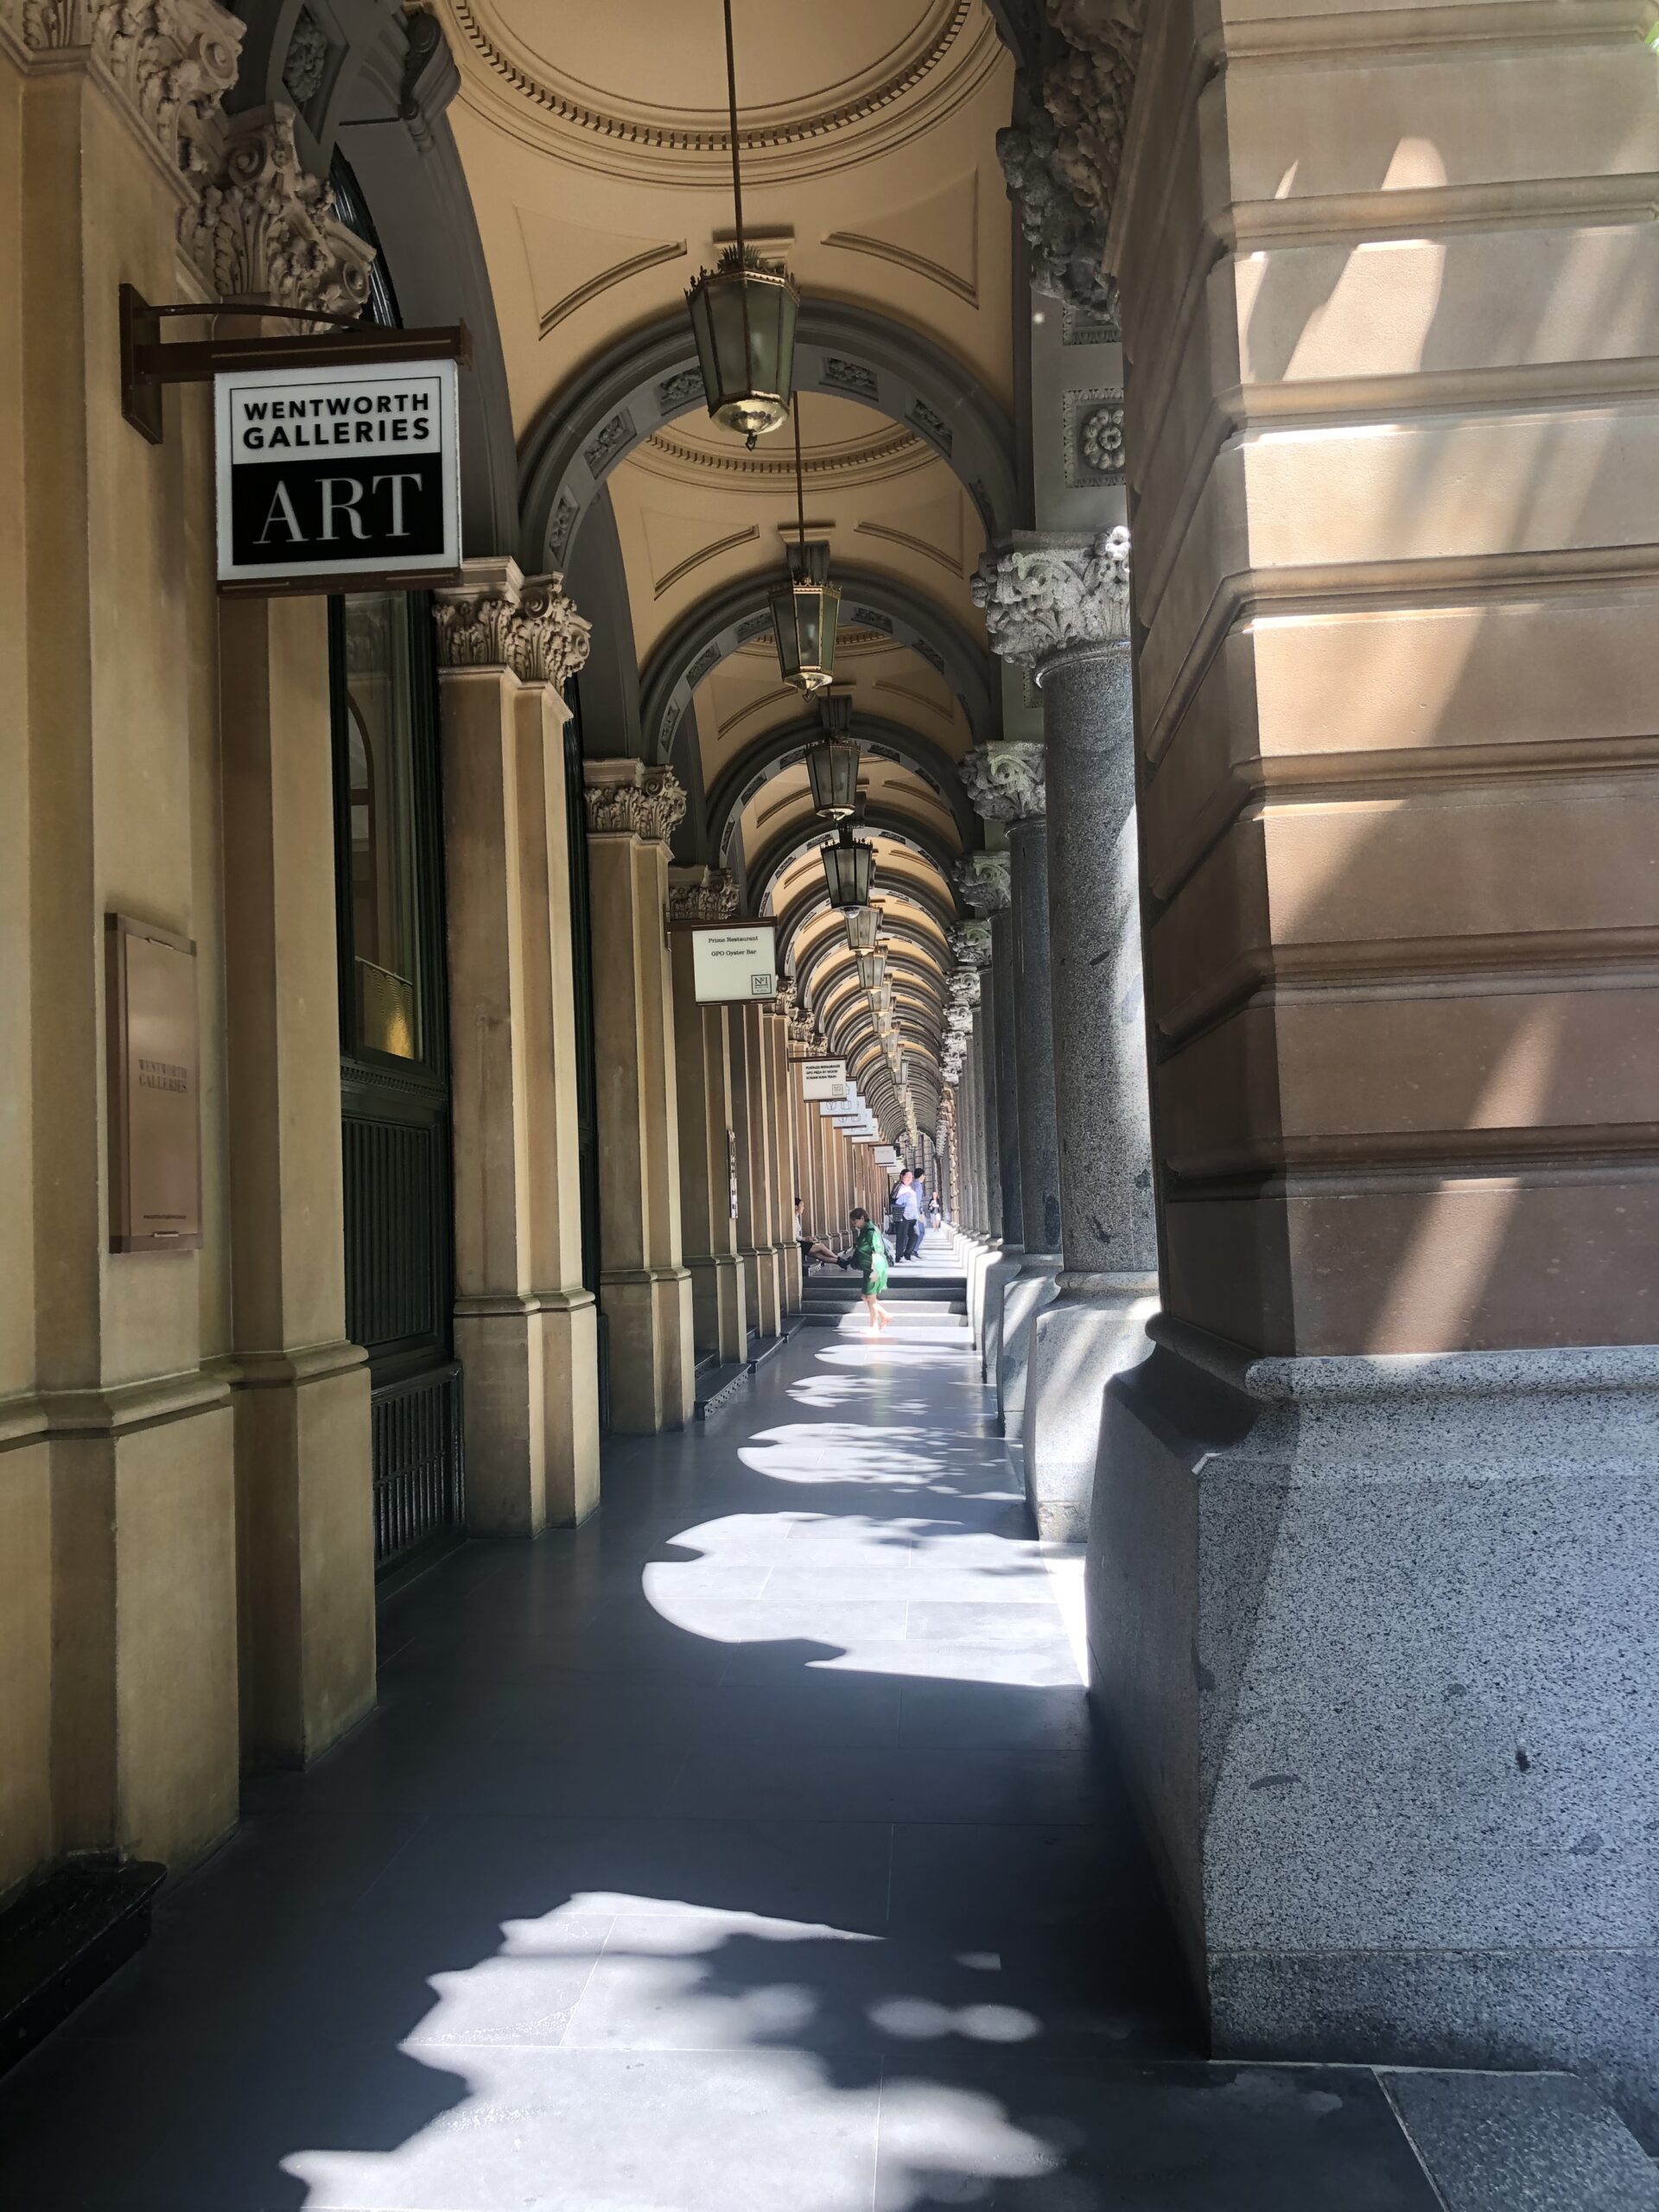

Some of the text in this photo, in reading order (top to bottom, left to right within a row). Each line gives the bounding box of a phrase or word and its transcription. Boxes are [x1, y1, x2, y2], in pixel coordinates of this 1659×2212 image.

[244, 393, 429, 421] WENTWORTH
[243, 417, 429, 449] GALLERIES
[252, 474, 423, 544] ART
[138, 1058, 188, 1079] WENTWORTH
[139, 1074, 188, 1094] GALLERIES
